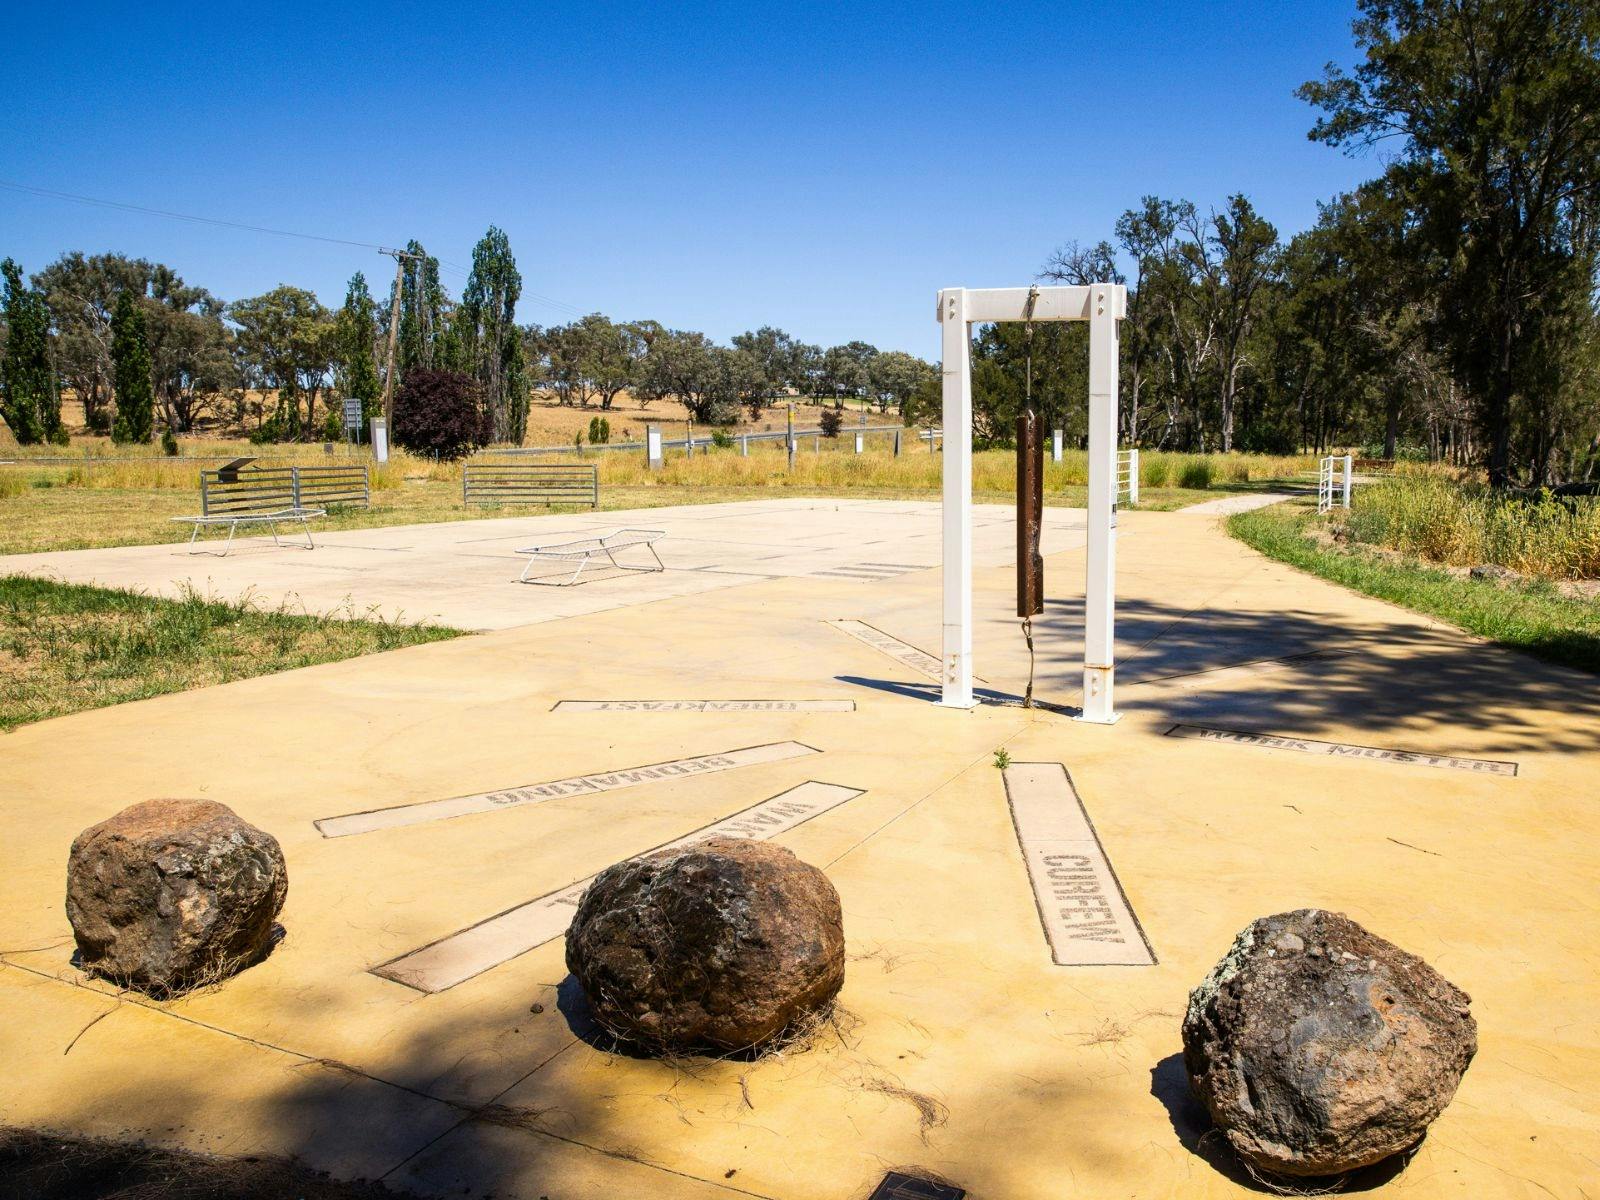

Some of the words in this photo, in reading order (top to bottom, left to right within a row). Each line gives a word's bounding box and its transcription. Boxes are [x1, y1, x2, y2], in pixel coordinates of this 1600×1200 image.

[592, 702, 797, 711] BREAKFAST
[1200, 729, 1308, 750] WORK
[1326, 745, 1502, 772] MUSTER
[486, 757, 735, 804] BEDMAKING
[700, 801, 818, 841] WAK
[1043, 855, 1126, 943] CURFEW
